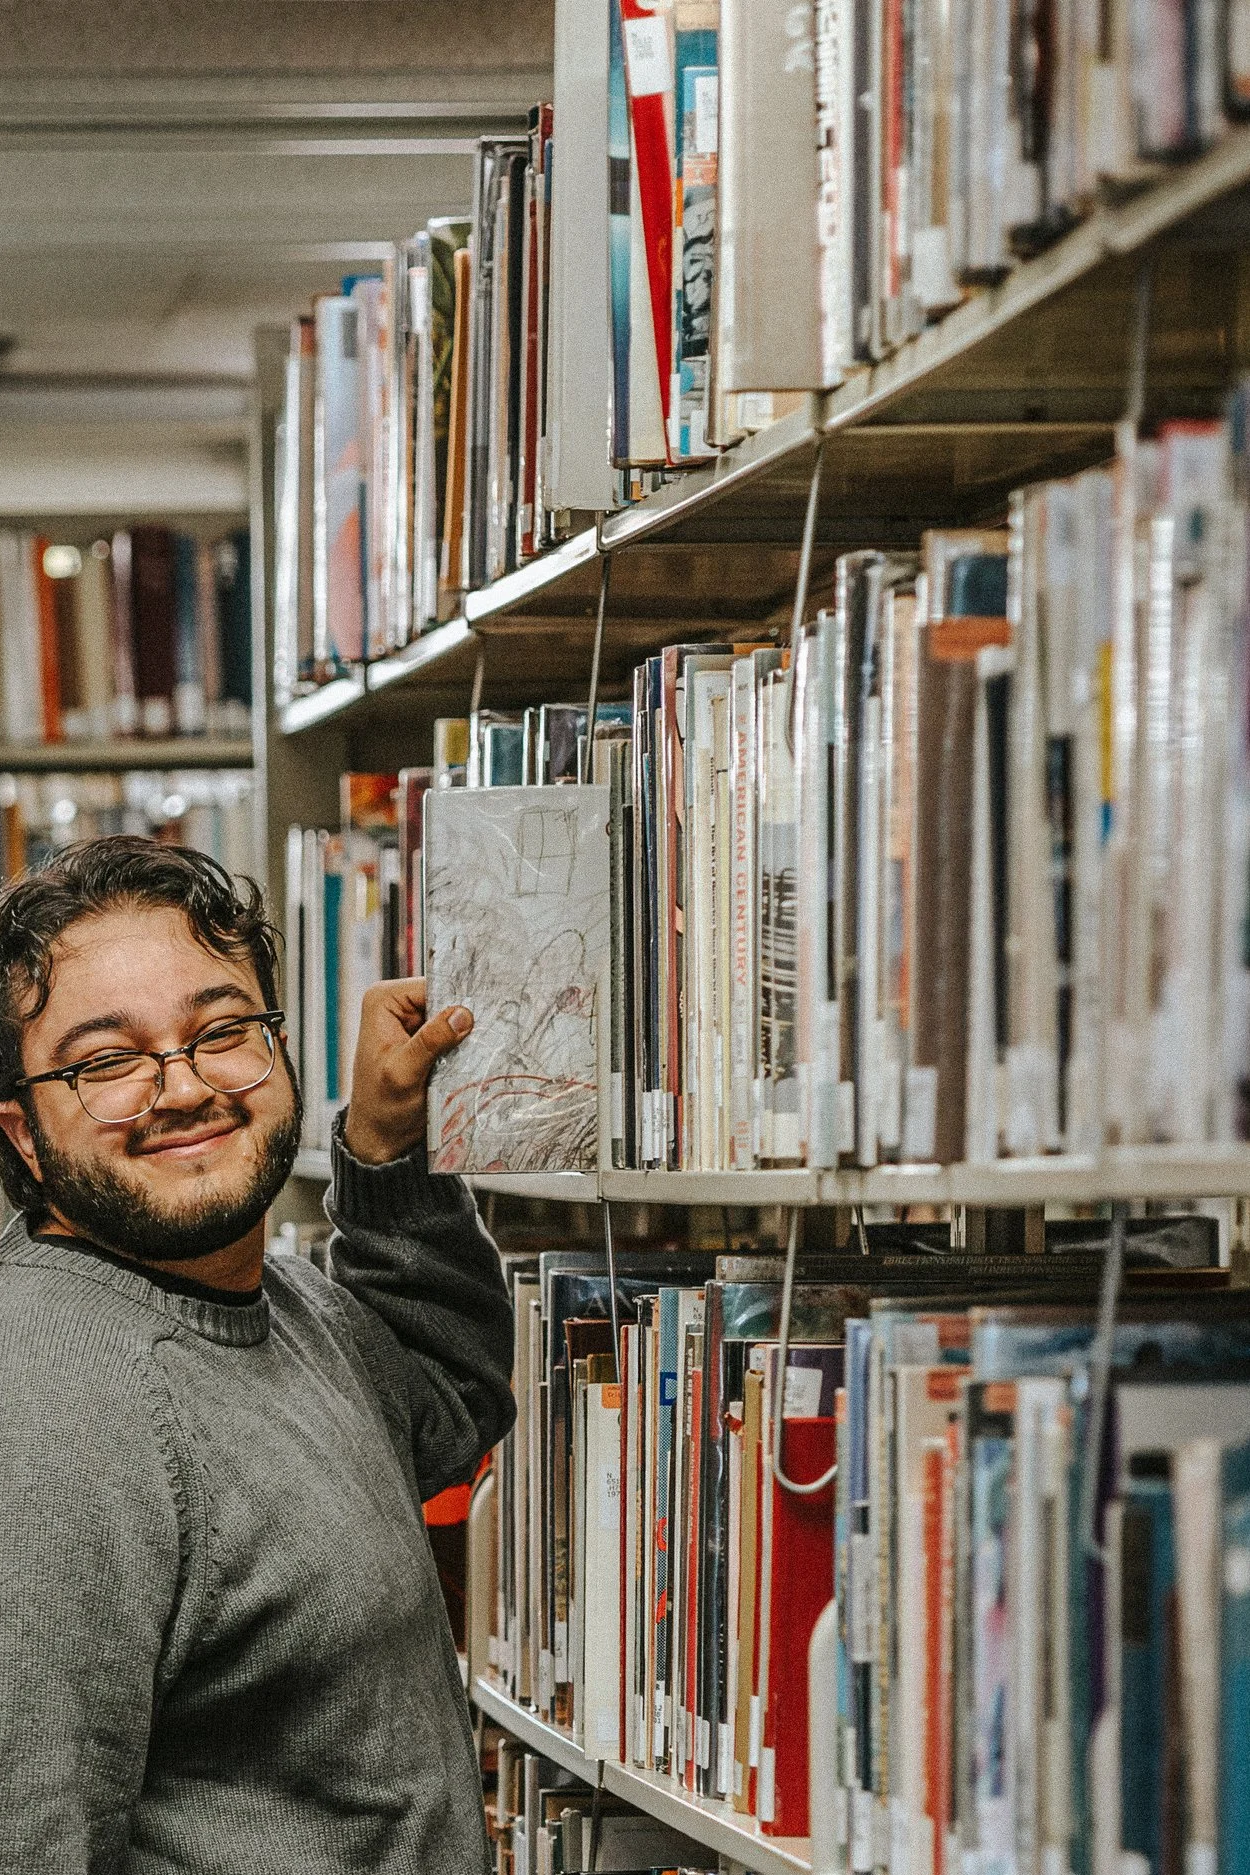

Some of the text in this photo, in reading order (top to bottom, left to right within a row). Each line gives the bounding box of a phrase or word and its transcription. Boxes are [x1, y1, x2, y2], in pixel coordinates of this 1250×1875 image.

[736, 731, 748, 861] AMERICAN
[736, 872, 748, 987] CENTURY
[686, 1347, 694, 1375] USA
[685, 1396, 693, 1436] Made
